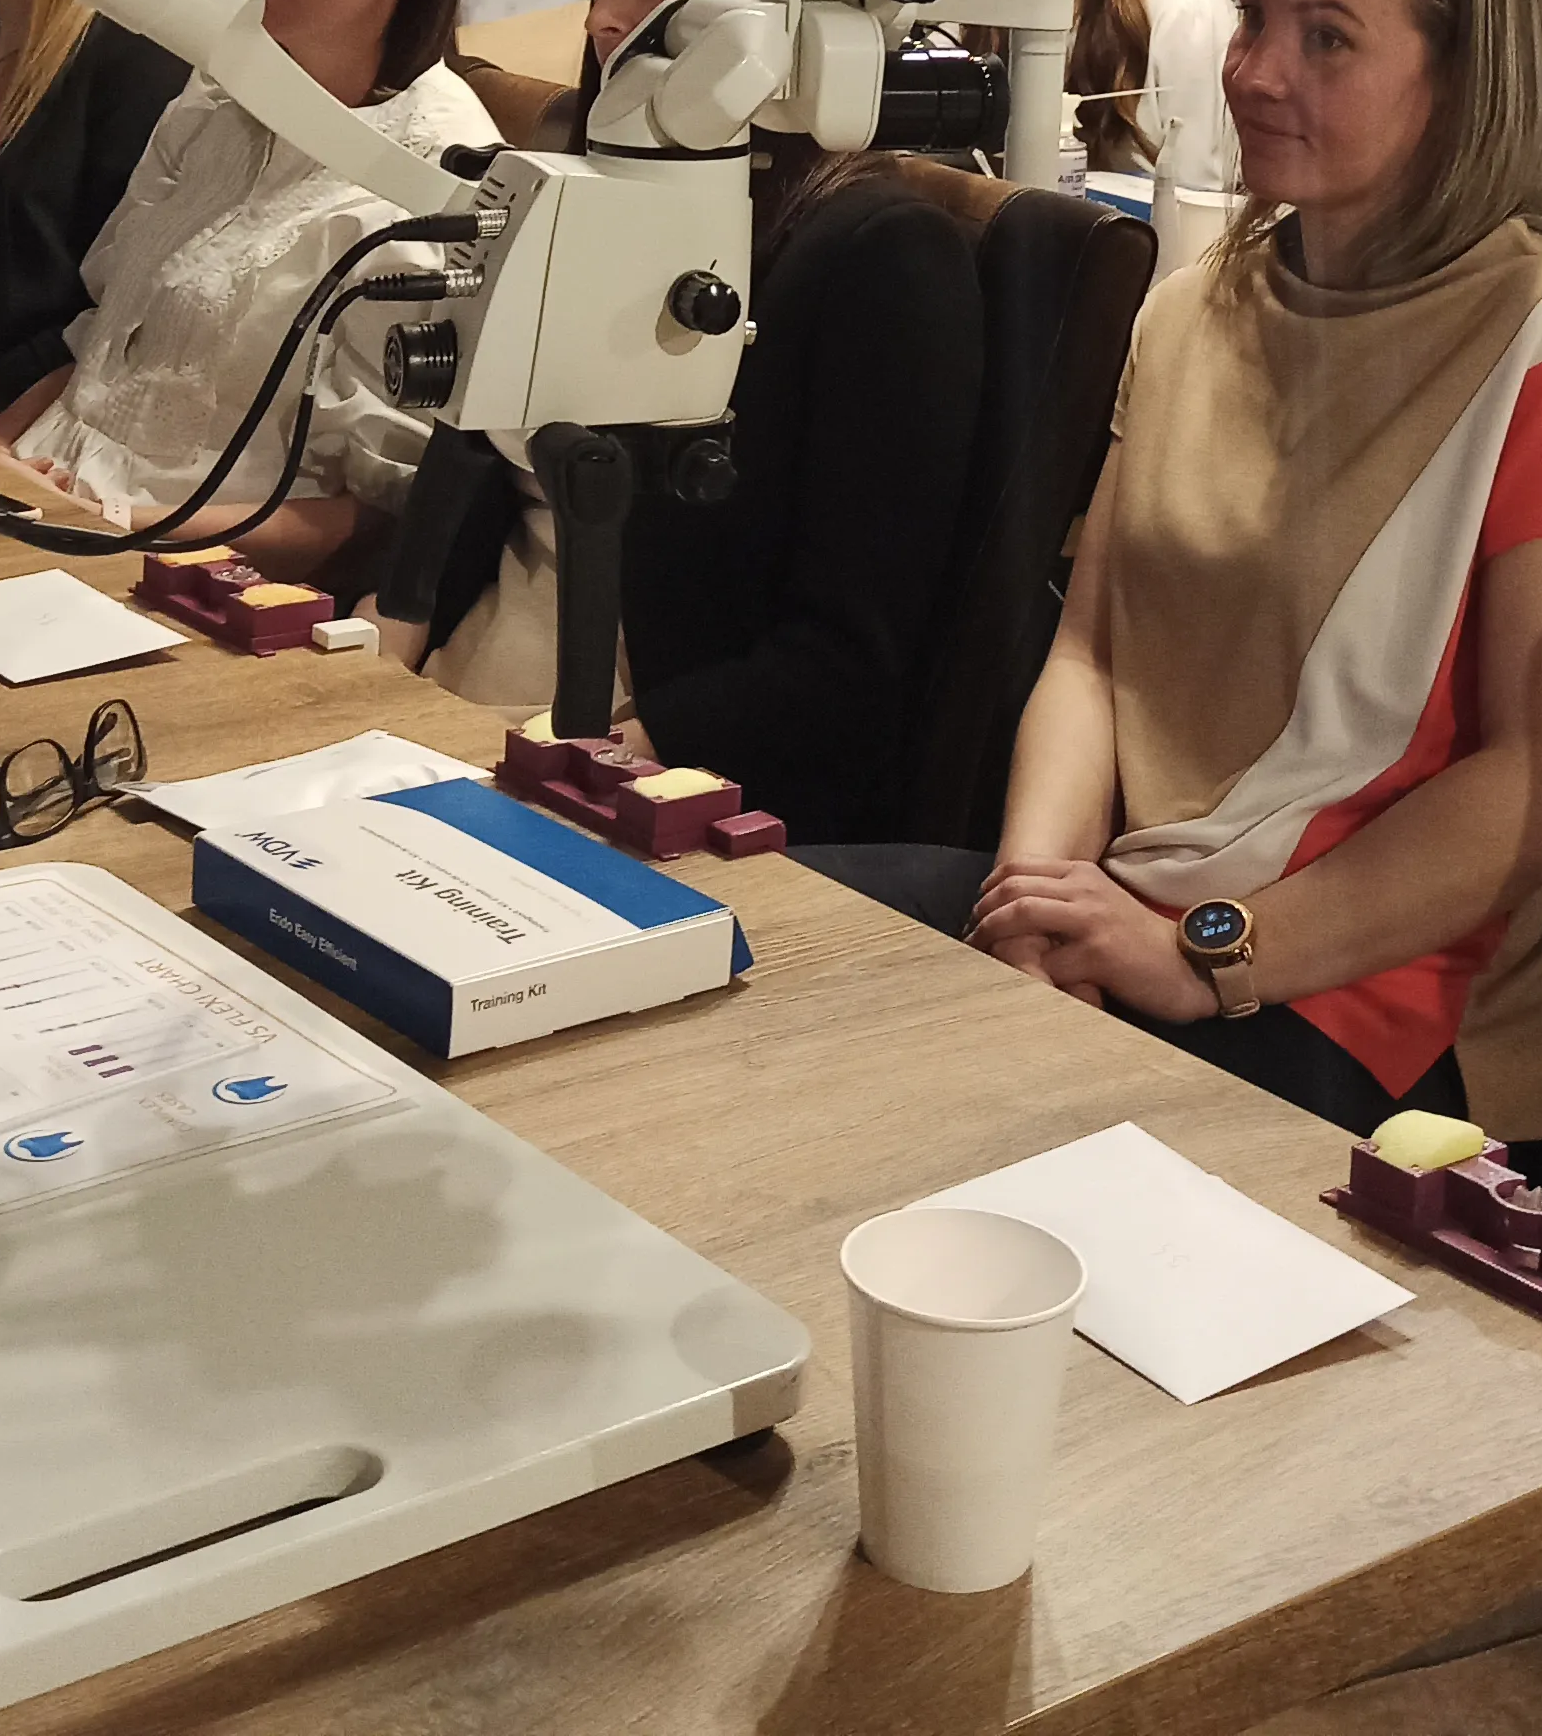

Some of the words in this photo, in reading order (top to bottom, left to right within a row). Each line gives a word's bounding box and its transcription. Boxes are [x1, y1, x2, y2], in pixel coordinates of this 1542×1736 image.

[394, 868, 439, 892] Kit
[434, 888, 527, 946] Training
[135, 957, 203, 996] CHART
[470, 991, 524, 1014] Training
[527, 982, 548, 999] Kit
